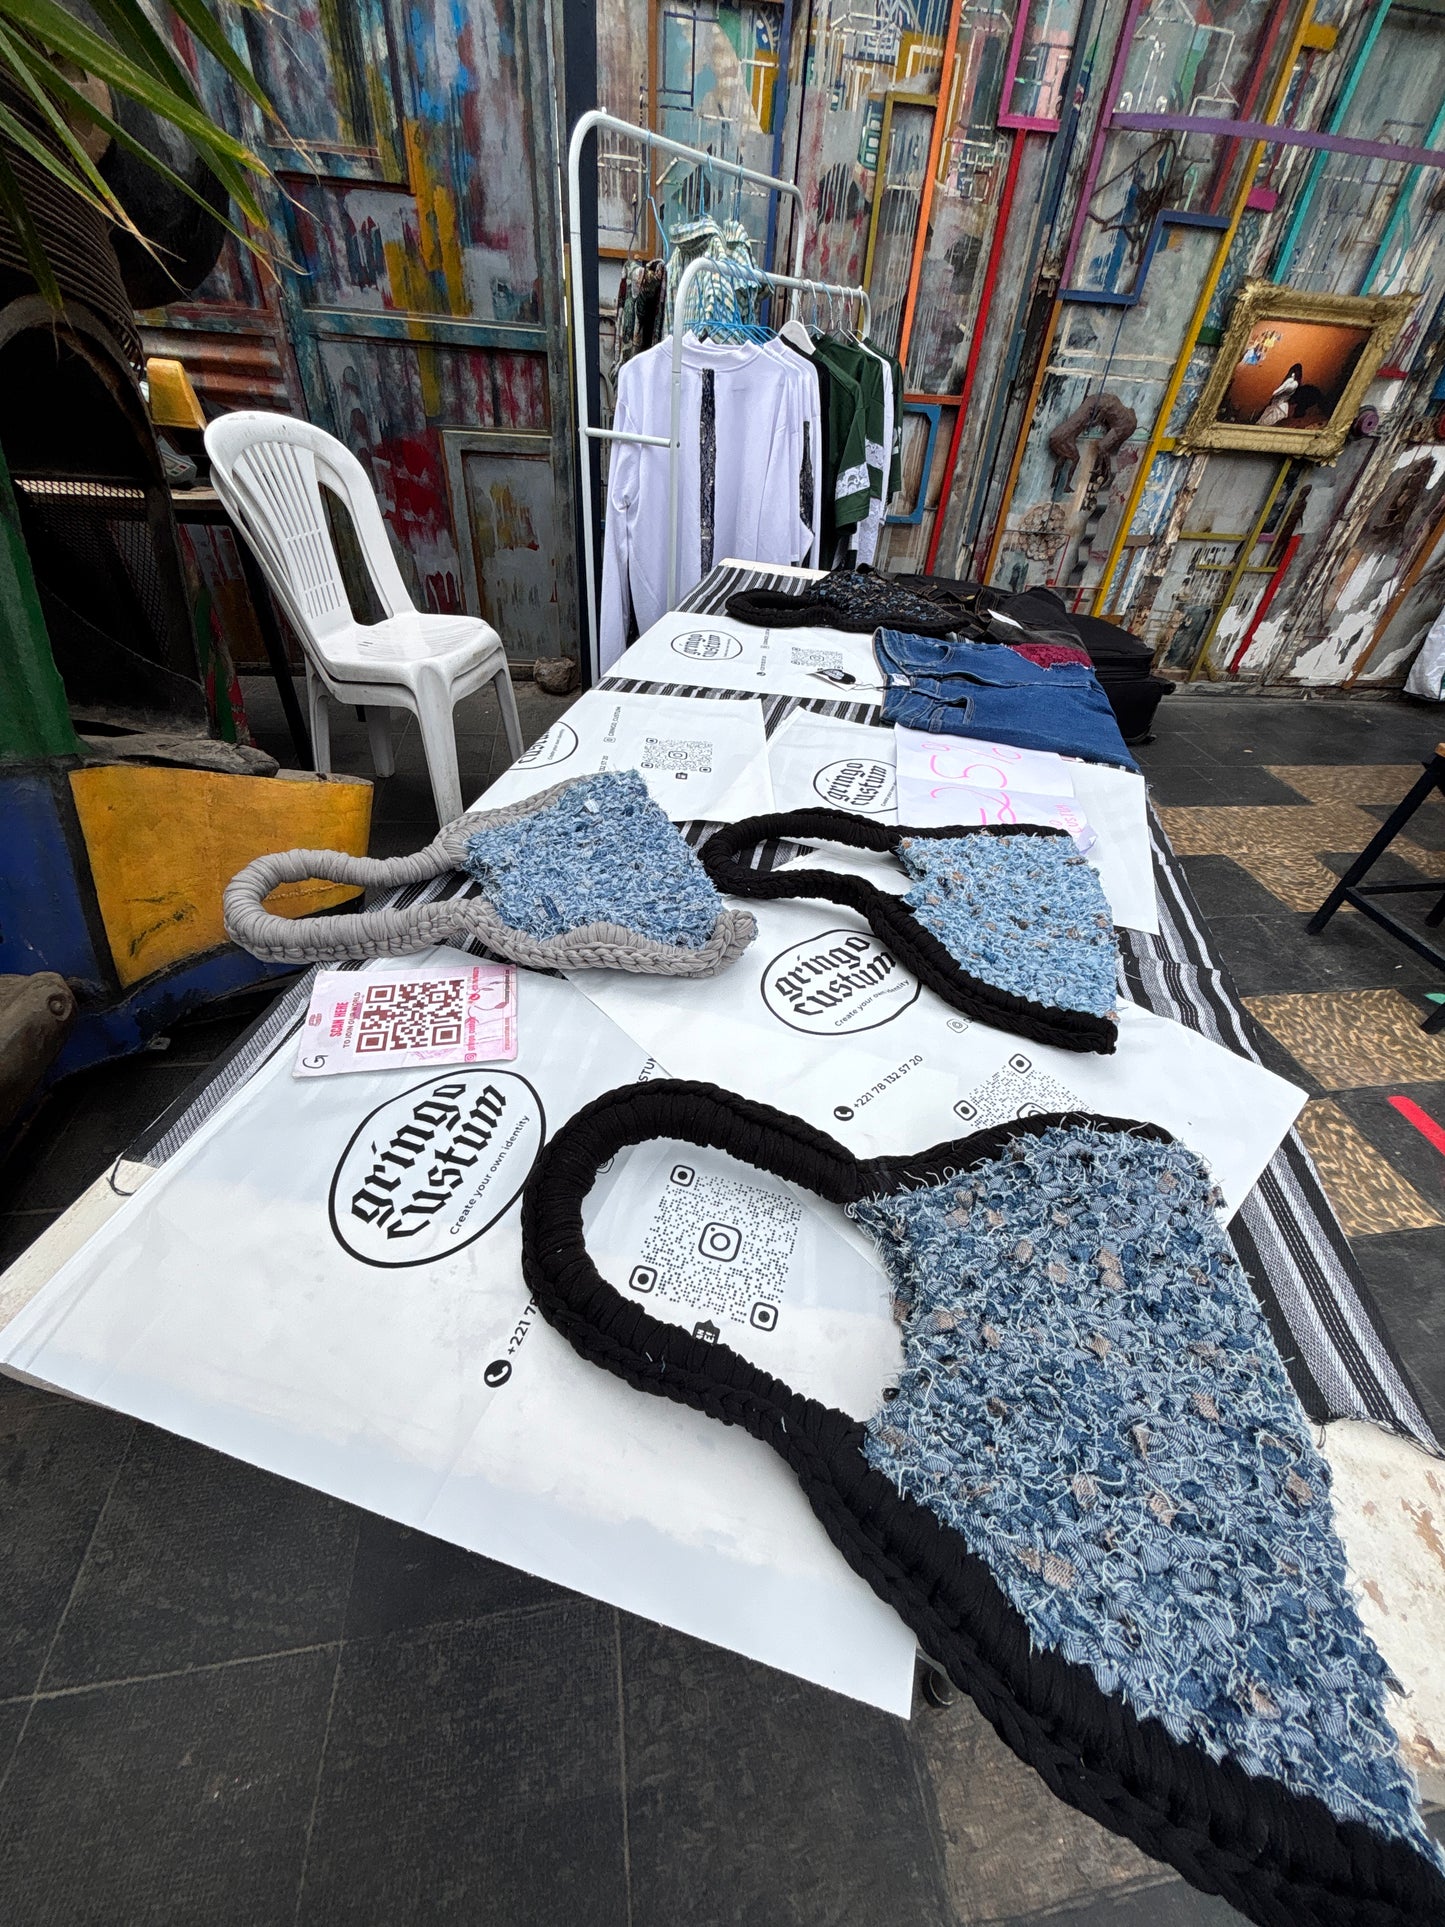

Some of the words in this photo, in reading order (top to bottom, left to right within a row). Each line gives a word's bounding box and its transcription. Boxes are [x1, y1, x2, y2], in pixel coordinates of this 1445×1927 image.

[774, 936, 871, 1002] gringo
[793, 952, 896, 1016] custum
[330, 1019, 345, 1037] SCAN
[333, 1001, 349, 1017] HERE
[834, 1008, 858, 1027] Create
[857, 996, 873, 1011] your
[343, 1040, 351, 1049] TO
[345, 1026, 354, 1038] JOIN
[853, 1091, 875, 1109] +221
[871, 1082, 887, 1094] 78
[883, 1071, 901, 1085] 132
[898, 1063, 911, 1075] 57
[909, 1054, 923, 1066] 20
[351, 1084, 466, 1228] gringo
[387, 1084, 506, 1239] custum
[450, 1198, 477, 1235] Create
[473, 1174, 492, 1198] your
[490, 1151, 507, 1173] own
[501, 1115, 530, 1150] identity
[507, 1320, 531, 1355] +221
